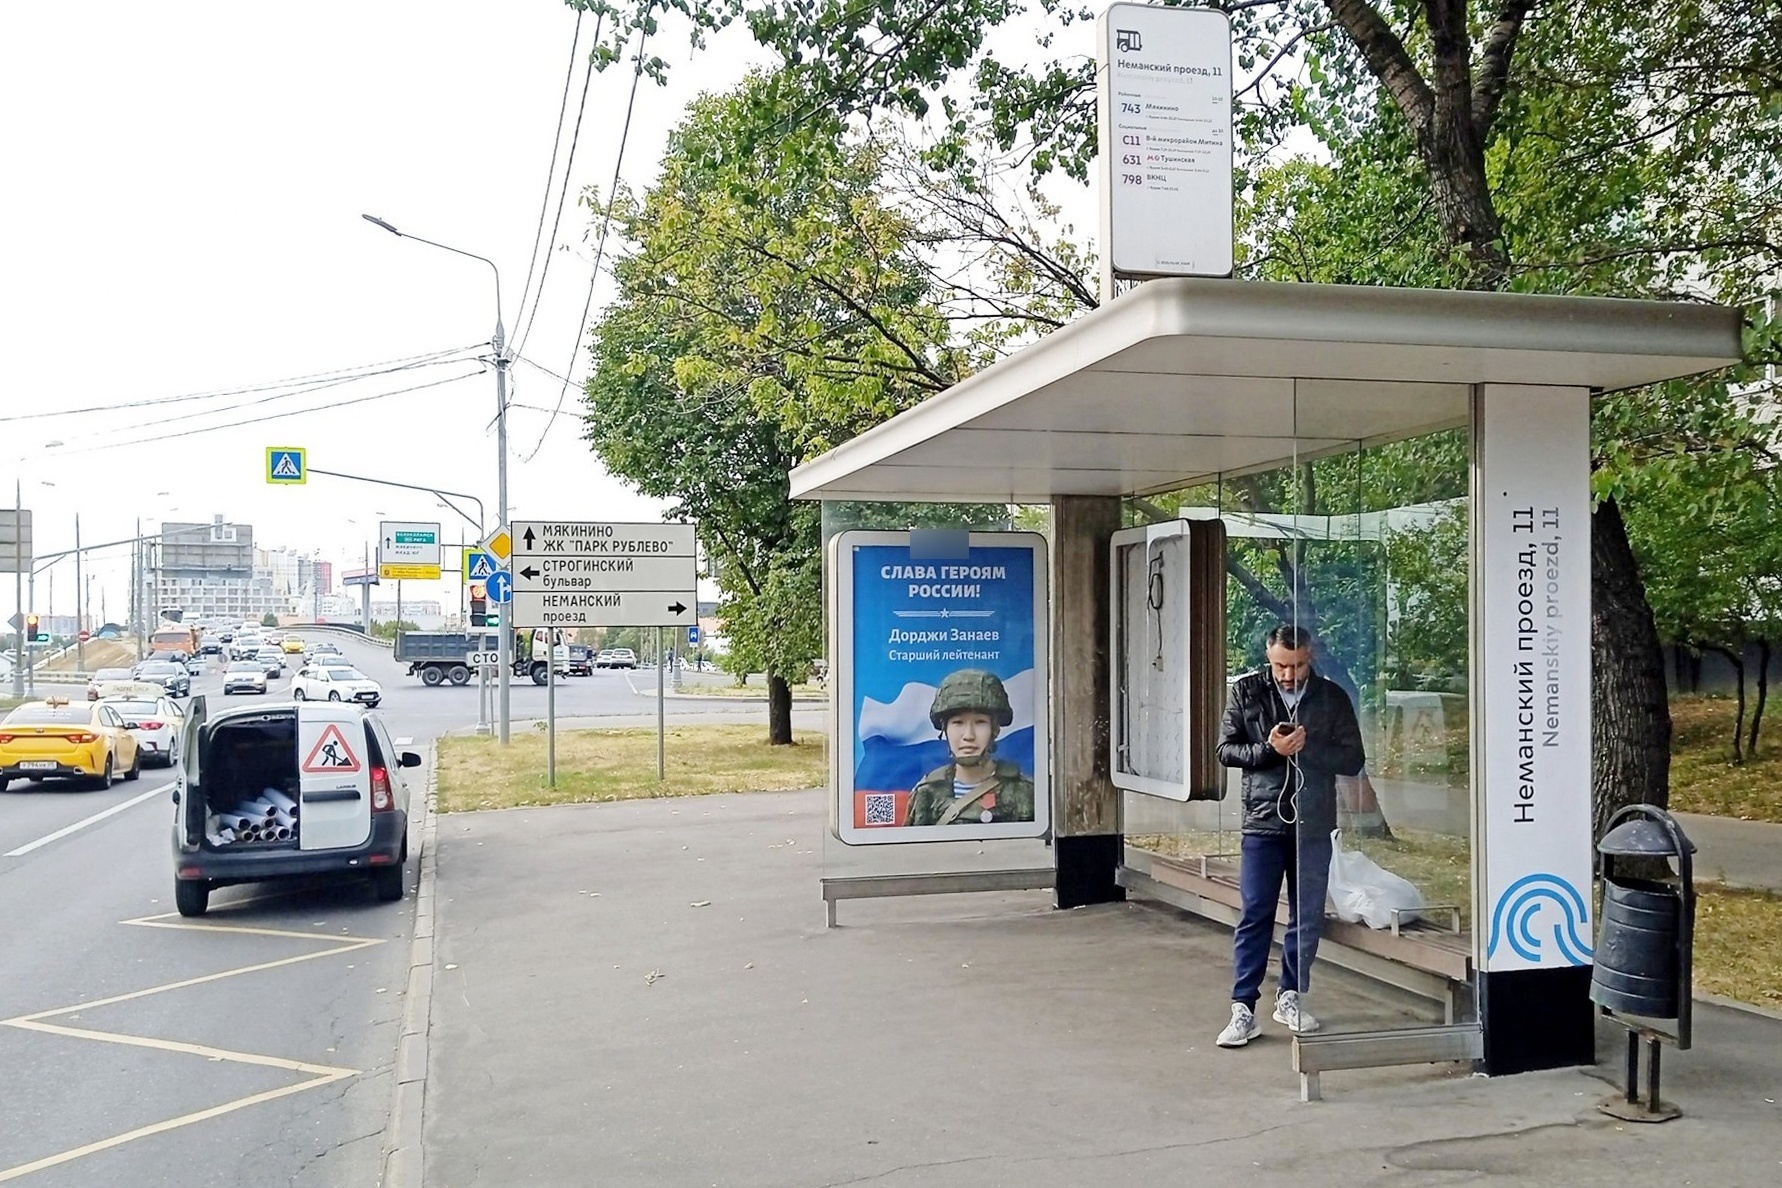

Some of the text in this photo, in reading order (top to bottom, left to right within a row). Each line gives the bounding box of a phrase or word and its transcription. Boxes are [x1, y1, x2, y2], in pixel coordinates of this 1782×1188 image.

[1117, 59, 1222, 77] Неманский проезд, 11
[1121, 102, 1179, 114] 743 Мякинино
[1158, 137, 1197, 146] микрорайон
[1122, 154, 1142, 165] 631
[1160, 155, 1195, 164] Тушинская
[1122, 174, 1167, 185] 798 ВКНЦ
[543, 525, 613, 538] МЯКИНИНО
[543, 540, 674, 553] ЖК "ПАРК РУБЛЕВО"
[543, 558, 634, 572] СТРОГИНСКИЙ
[881, 565, 1006, 580] СЛАВА ГЕРОЯМ
[543, 575, 591, 589] бульвар
[908, 584, 981, 598] РОССИИ!
[543, 593, 621, 607] НЕМАНСКИЙ
[543, 612, 587, 624] проезд
[1541, 507, 1563, 747] Nemanskiy proezd, 11
[888, 628, 999, 644] Дорджи Занаев
[473, 653, 499, 664] СТО
[889, 649, 1000, 663] Старший лейтенант
[1513, 506, 1538, 823] Неманский проезд, 11
